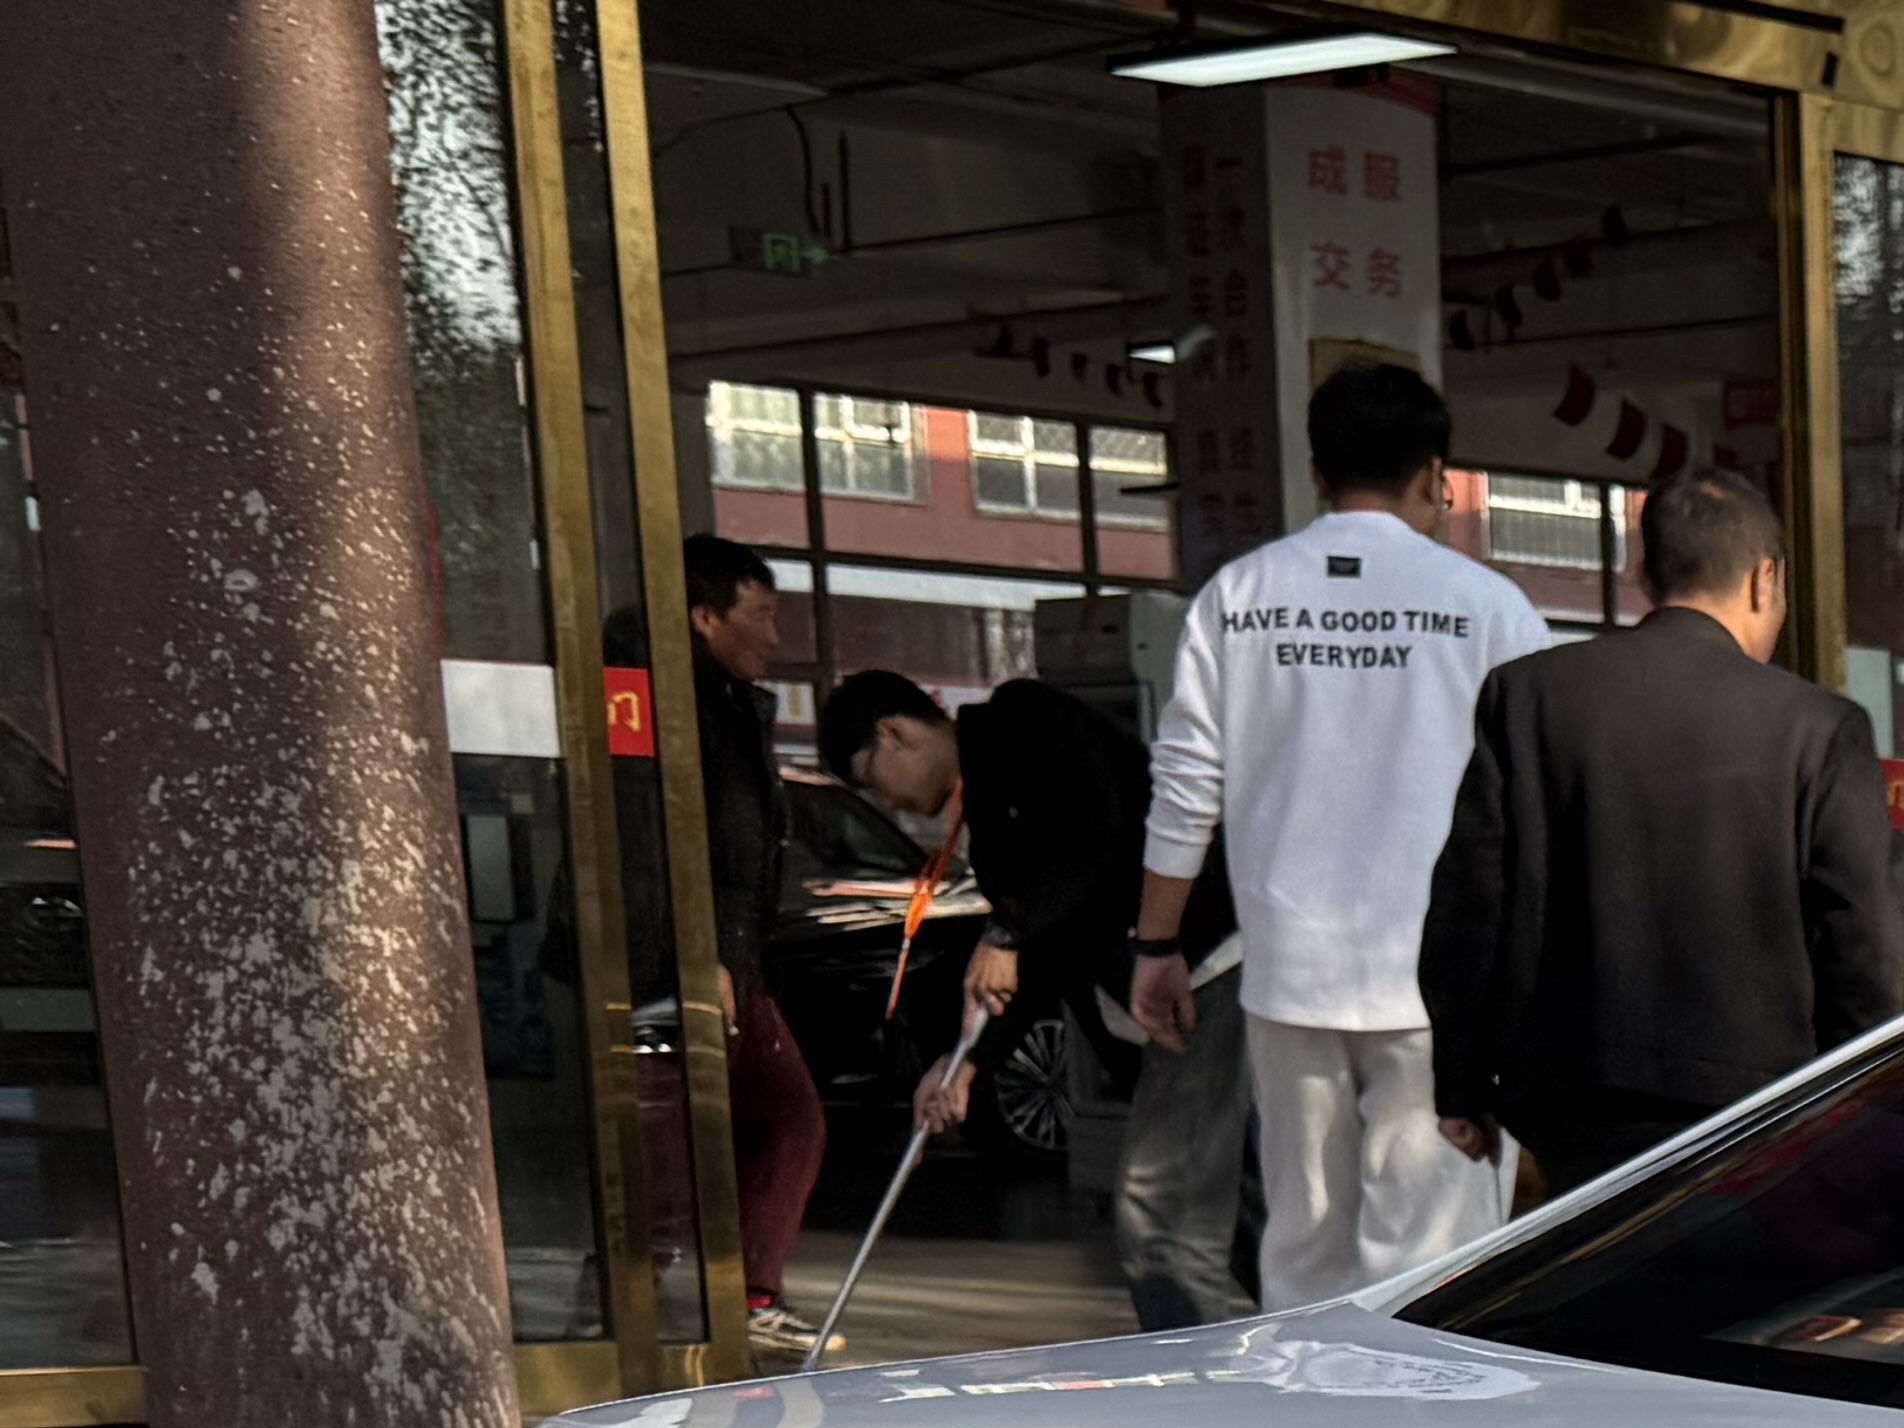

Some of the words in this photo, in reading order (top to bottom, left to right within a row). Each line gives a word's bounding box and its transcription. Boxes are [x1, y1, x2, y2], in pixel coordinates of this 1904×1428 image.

[1222, 607, 1290, 634] HAVE
[1296, 608, 1314, 629] A
[1320, 610, 1397, 633] GOOD
[1402, 610, 1472, 639] TIME
[1276, 642, 1412, 669] EVERYDAY
